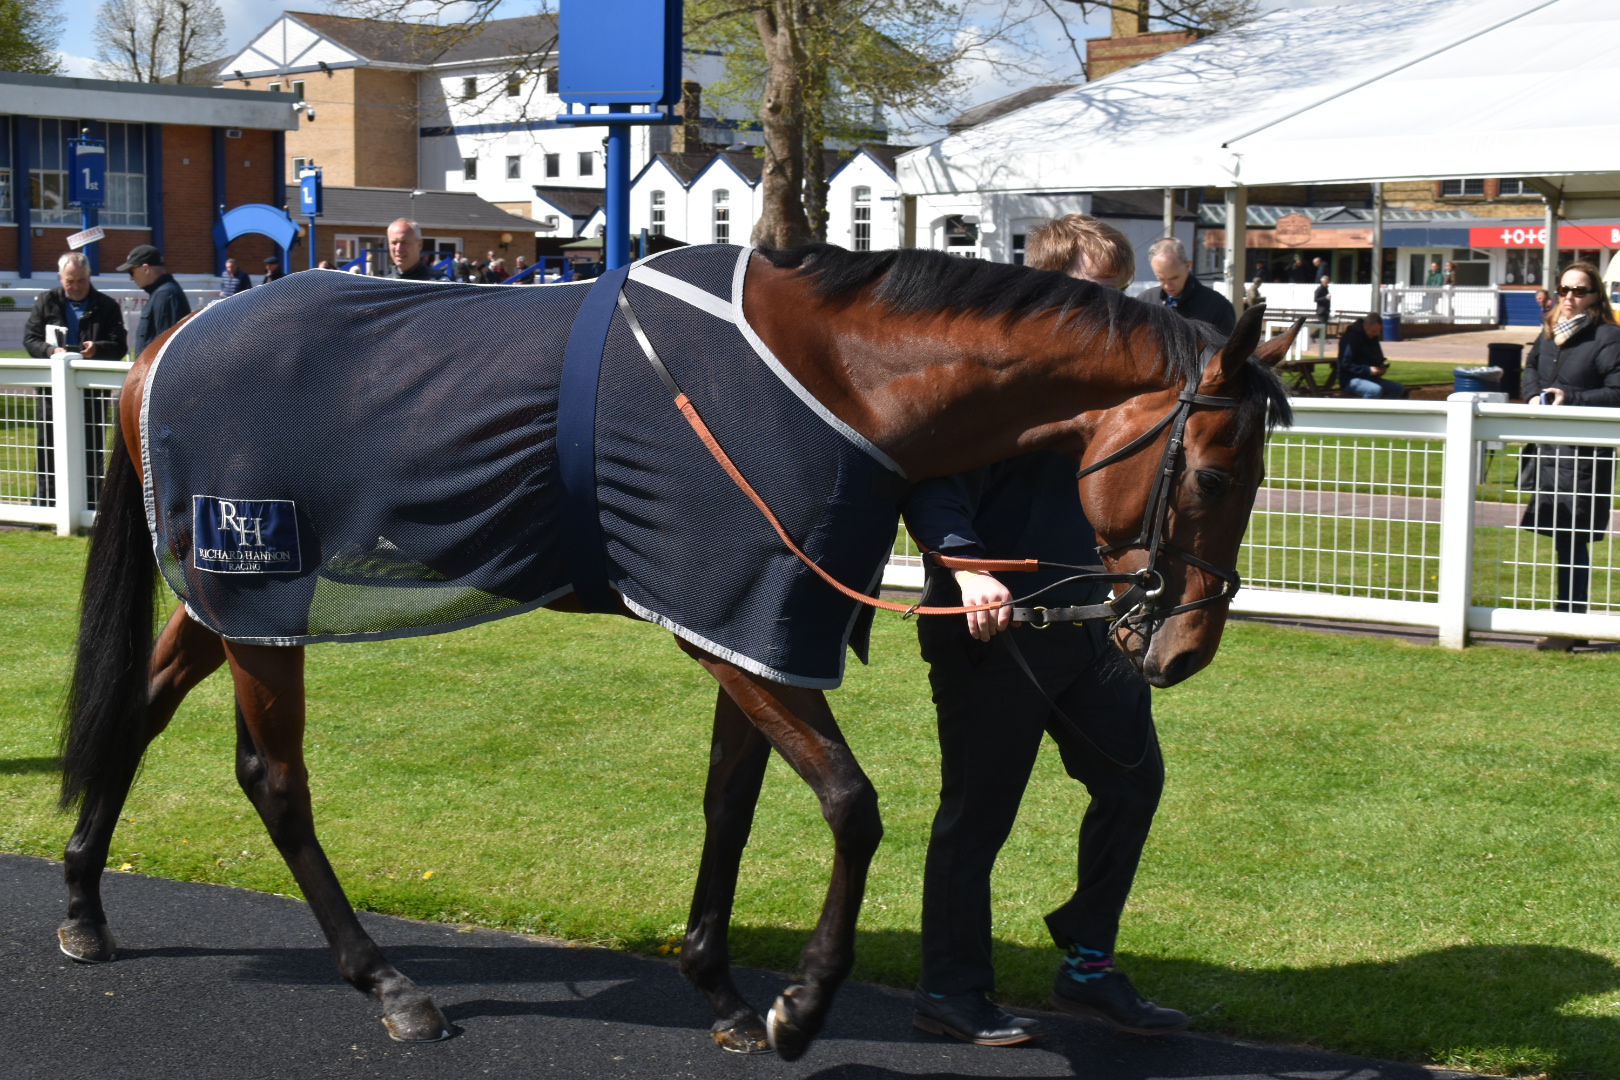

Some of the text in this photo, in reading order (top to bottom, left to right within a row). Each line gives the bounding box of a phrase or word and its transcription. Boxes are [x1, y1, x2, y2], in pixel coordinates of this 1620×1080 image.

[81, 167, 99, 190] 1st
[199, 547, 291, 561] RICHARD HANNON
[228, 562, 261, 571] RACING
